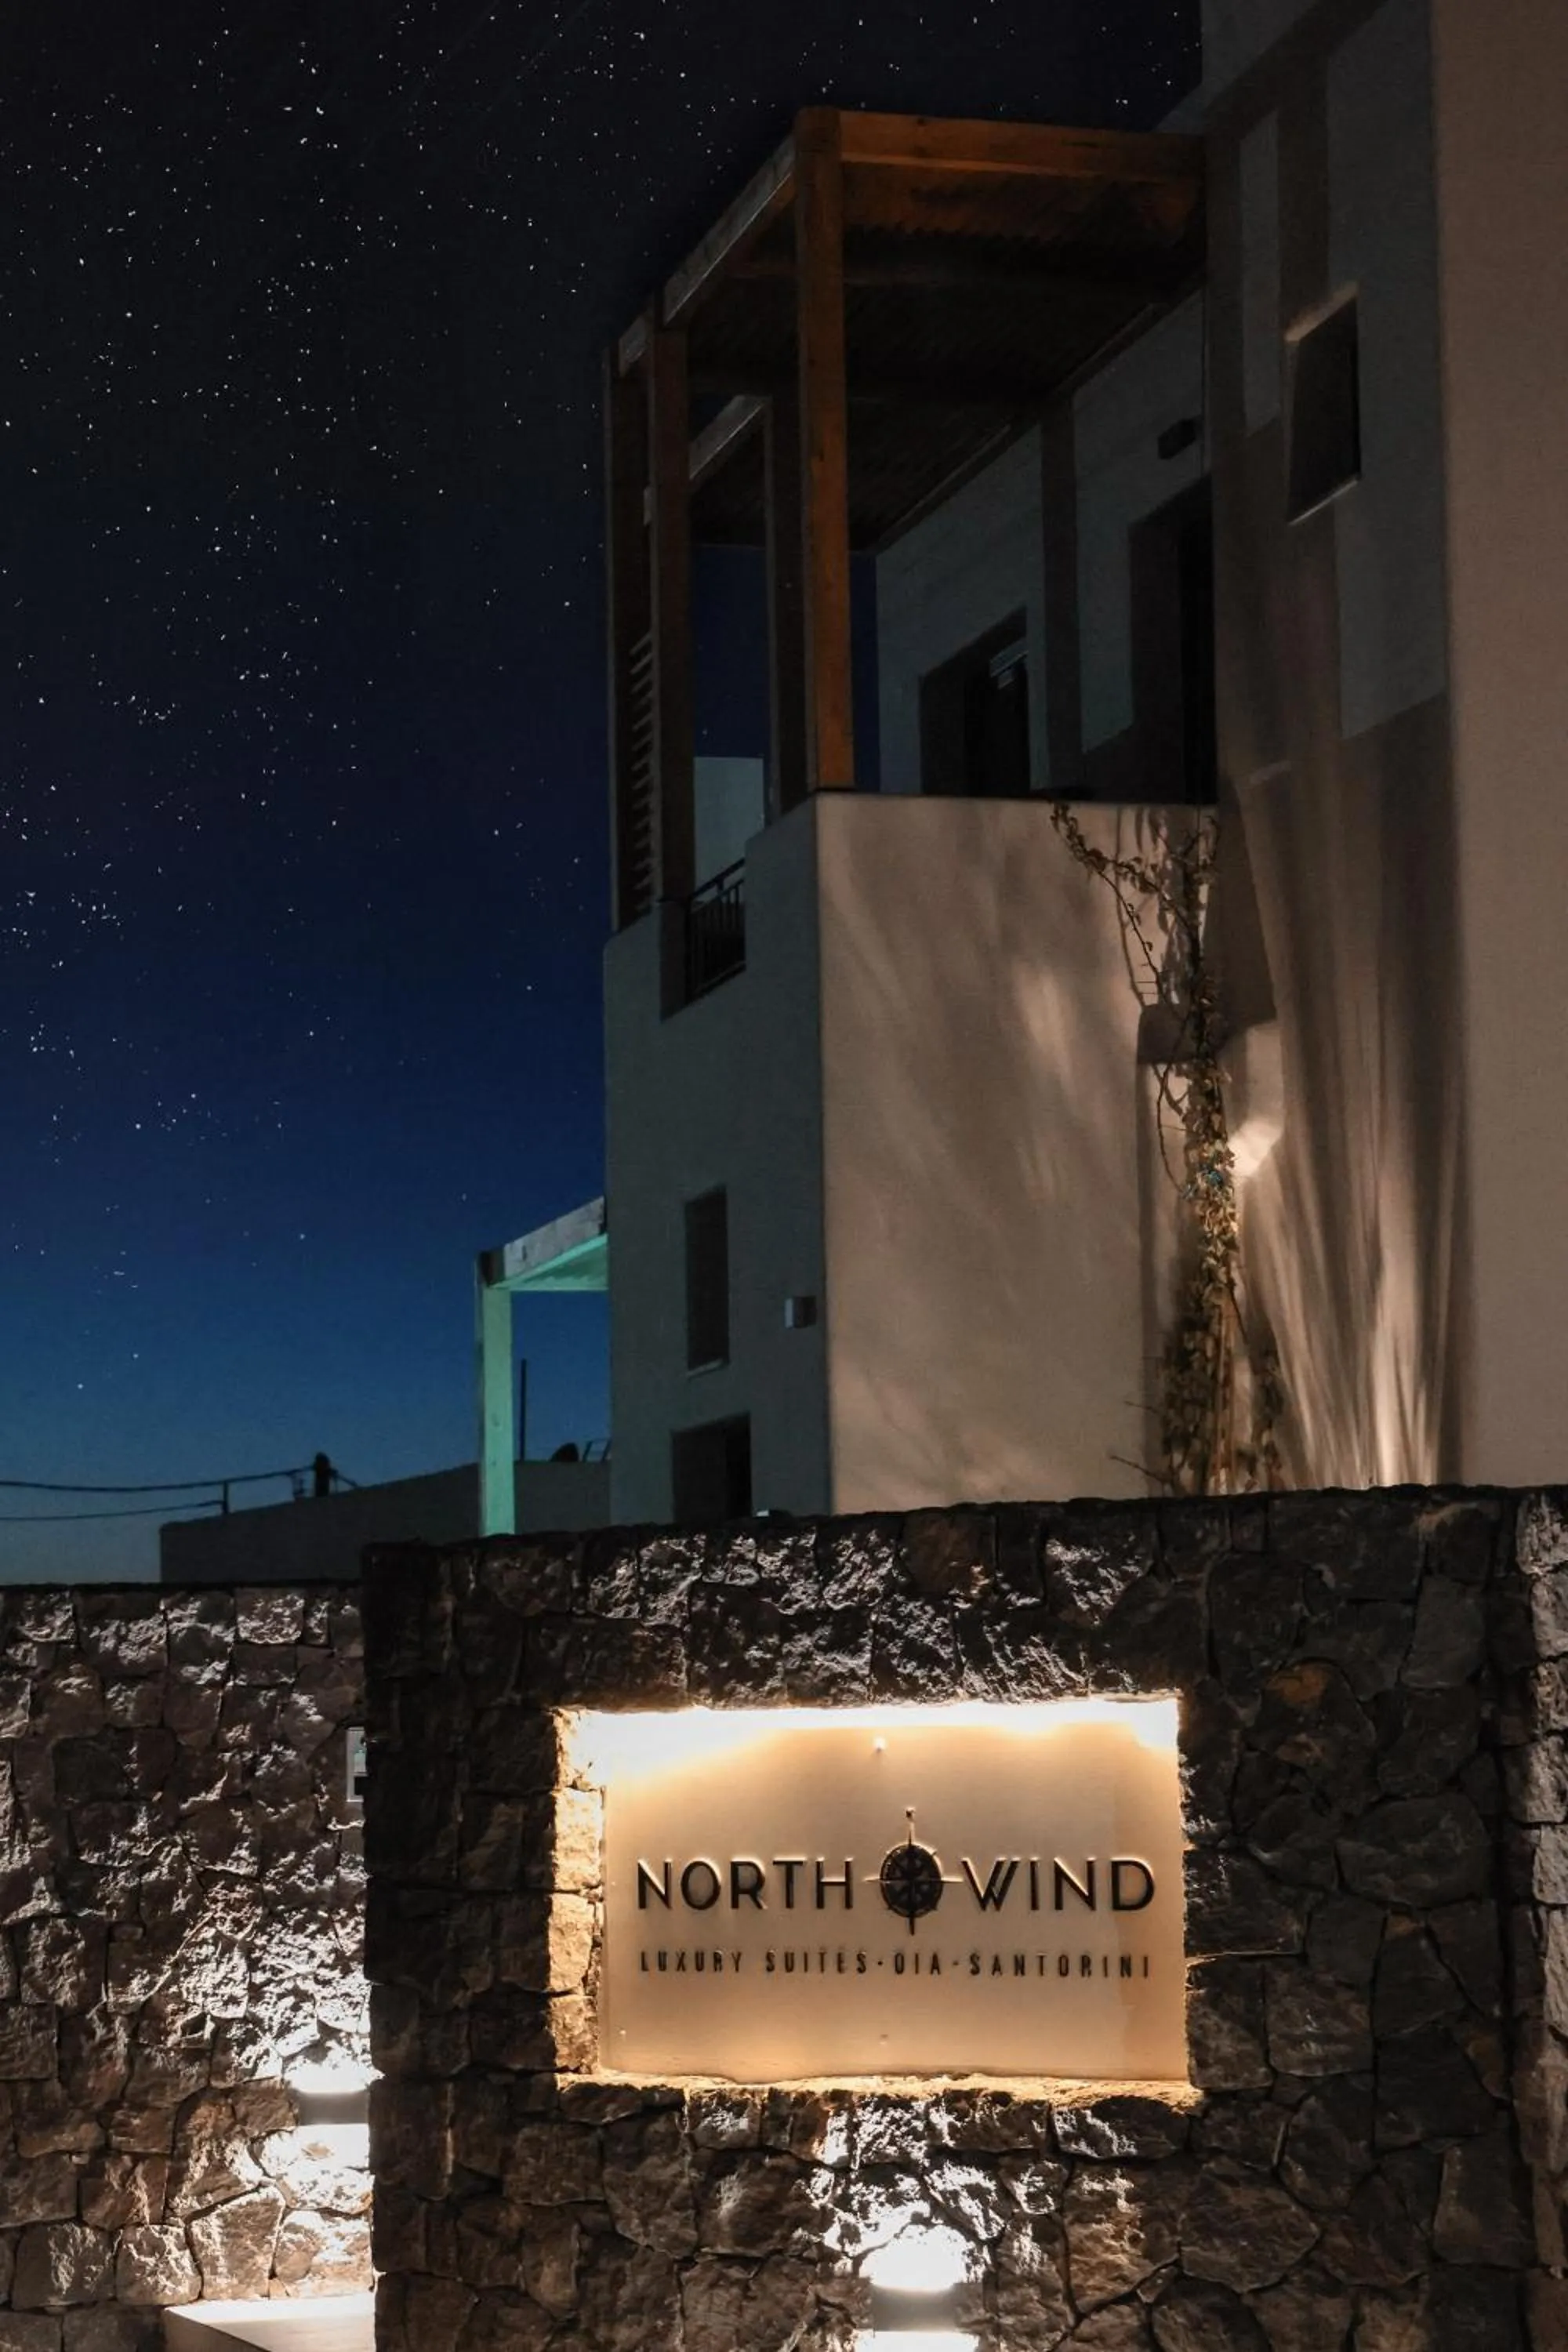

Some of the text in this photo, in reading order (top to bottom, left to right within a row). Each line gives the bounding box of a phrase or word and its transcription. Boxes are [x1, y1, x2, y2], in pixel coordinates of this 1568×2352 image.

[637, 1858, 1155, 1911] NORTH WIND
[640, 1951, 742, 1973] LUXURY
[765, 1951, 867, 1974] SUITES
[969, 1955, 1149, 1978] SANTORINI
